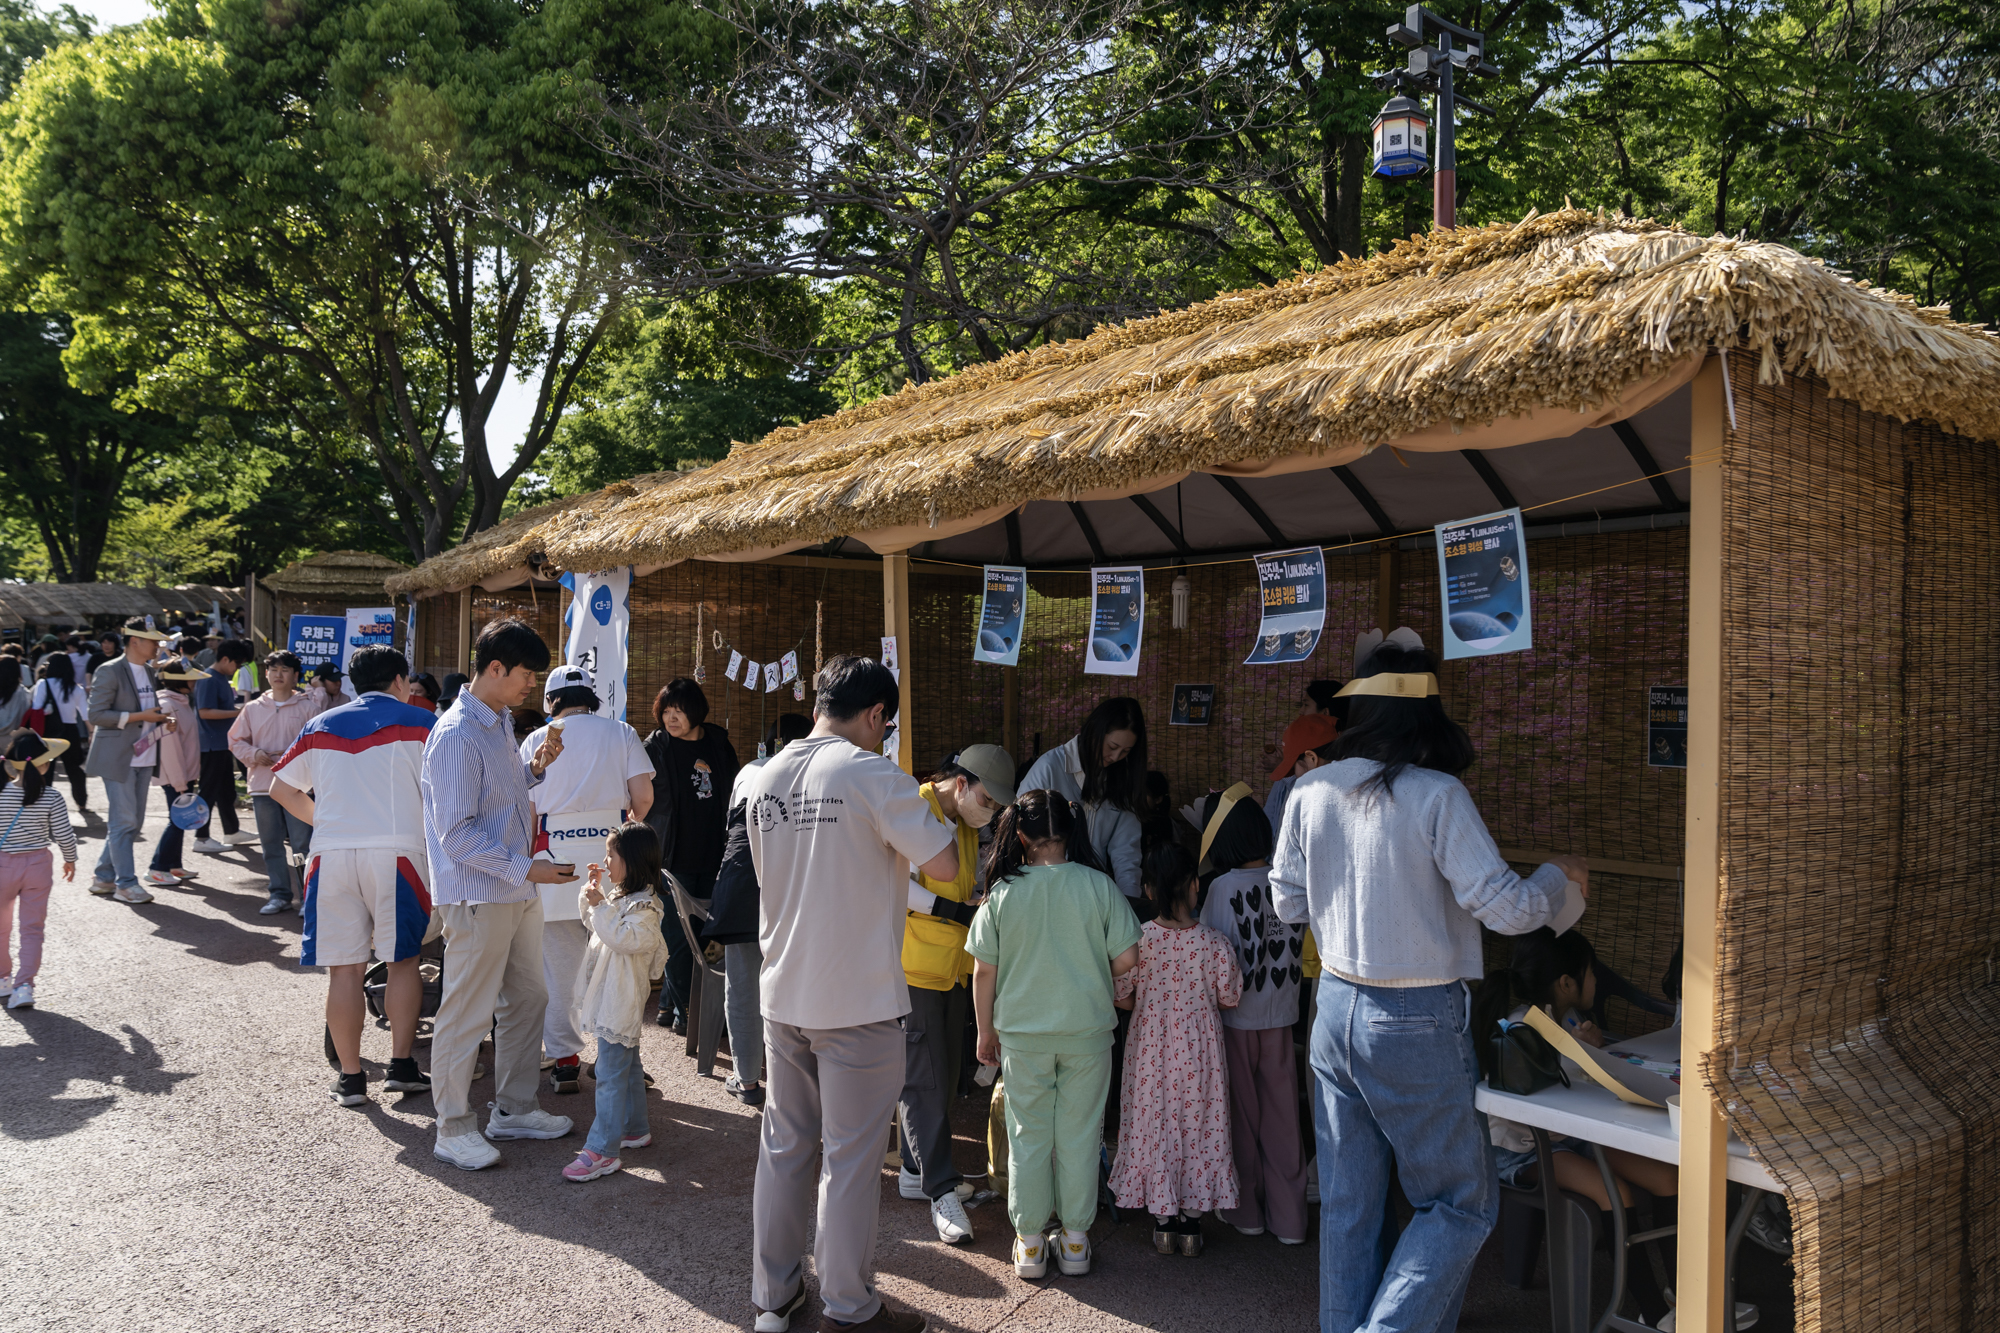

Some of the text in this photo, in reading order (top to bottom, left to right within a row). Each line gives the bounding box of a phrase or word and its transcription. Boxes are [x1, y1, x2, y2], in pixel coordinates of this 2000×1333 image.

[1445, 537, 1500, 558] 초소형 위성 발사
[1263, 584, 1309, 606] 초소형 위성 발사
[374, 614, 393, 623] 당신을
[301, 626, 335, 640] 우체국
[358, 623, 392, 634] 우체국FC
[294, 641, 339, 655] 잇다뱅킹
[1650, 709, 1666, 722] 초소형
[1667, 709, 1678, 722] 위성
[764, 793, 789, 823] bridge
[804, 797, 844, 806] memories
[1269, 921, 1281, 929] FUN
[1267, 928, 1284, 936] LOVE
